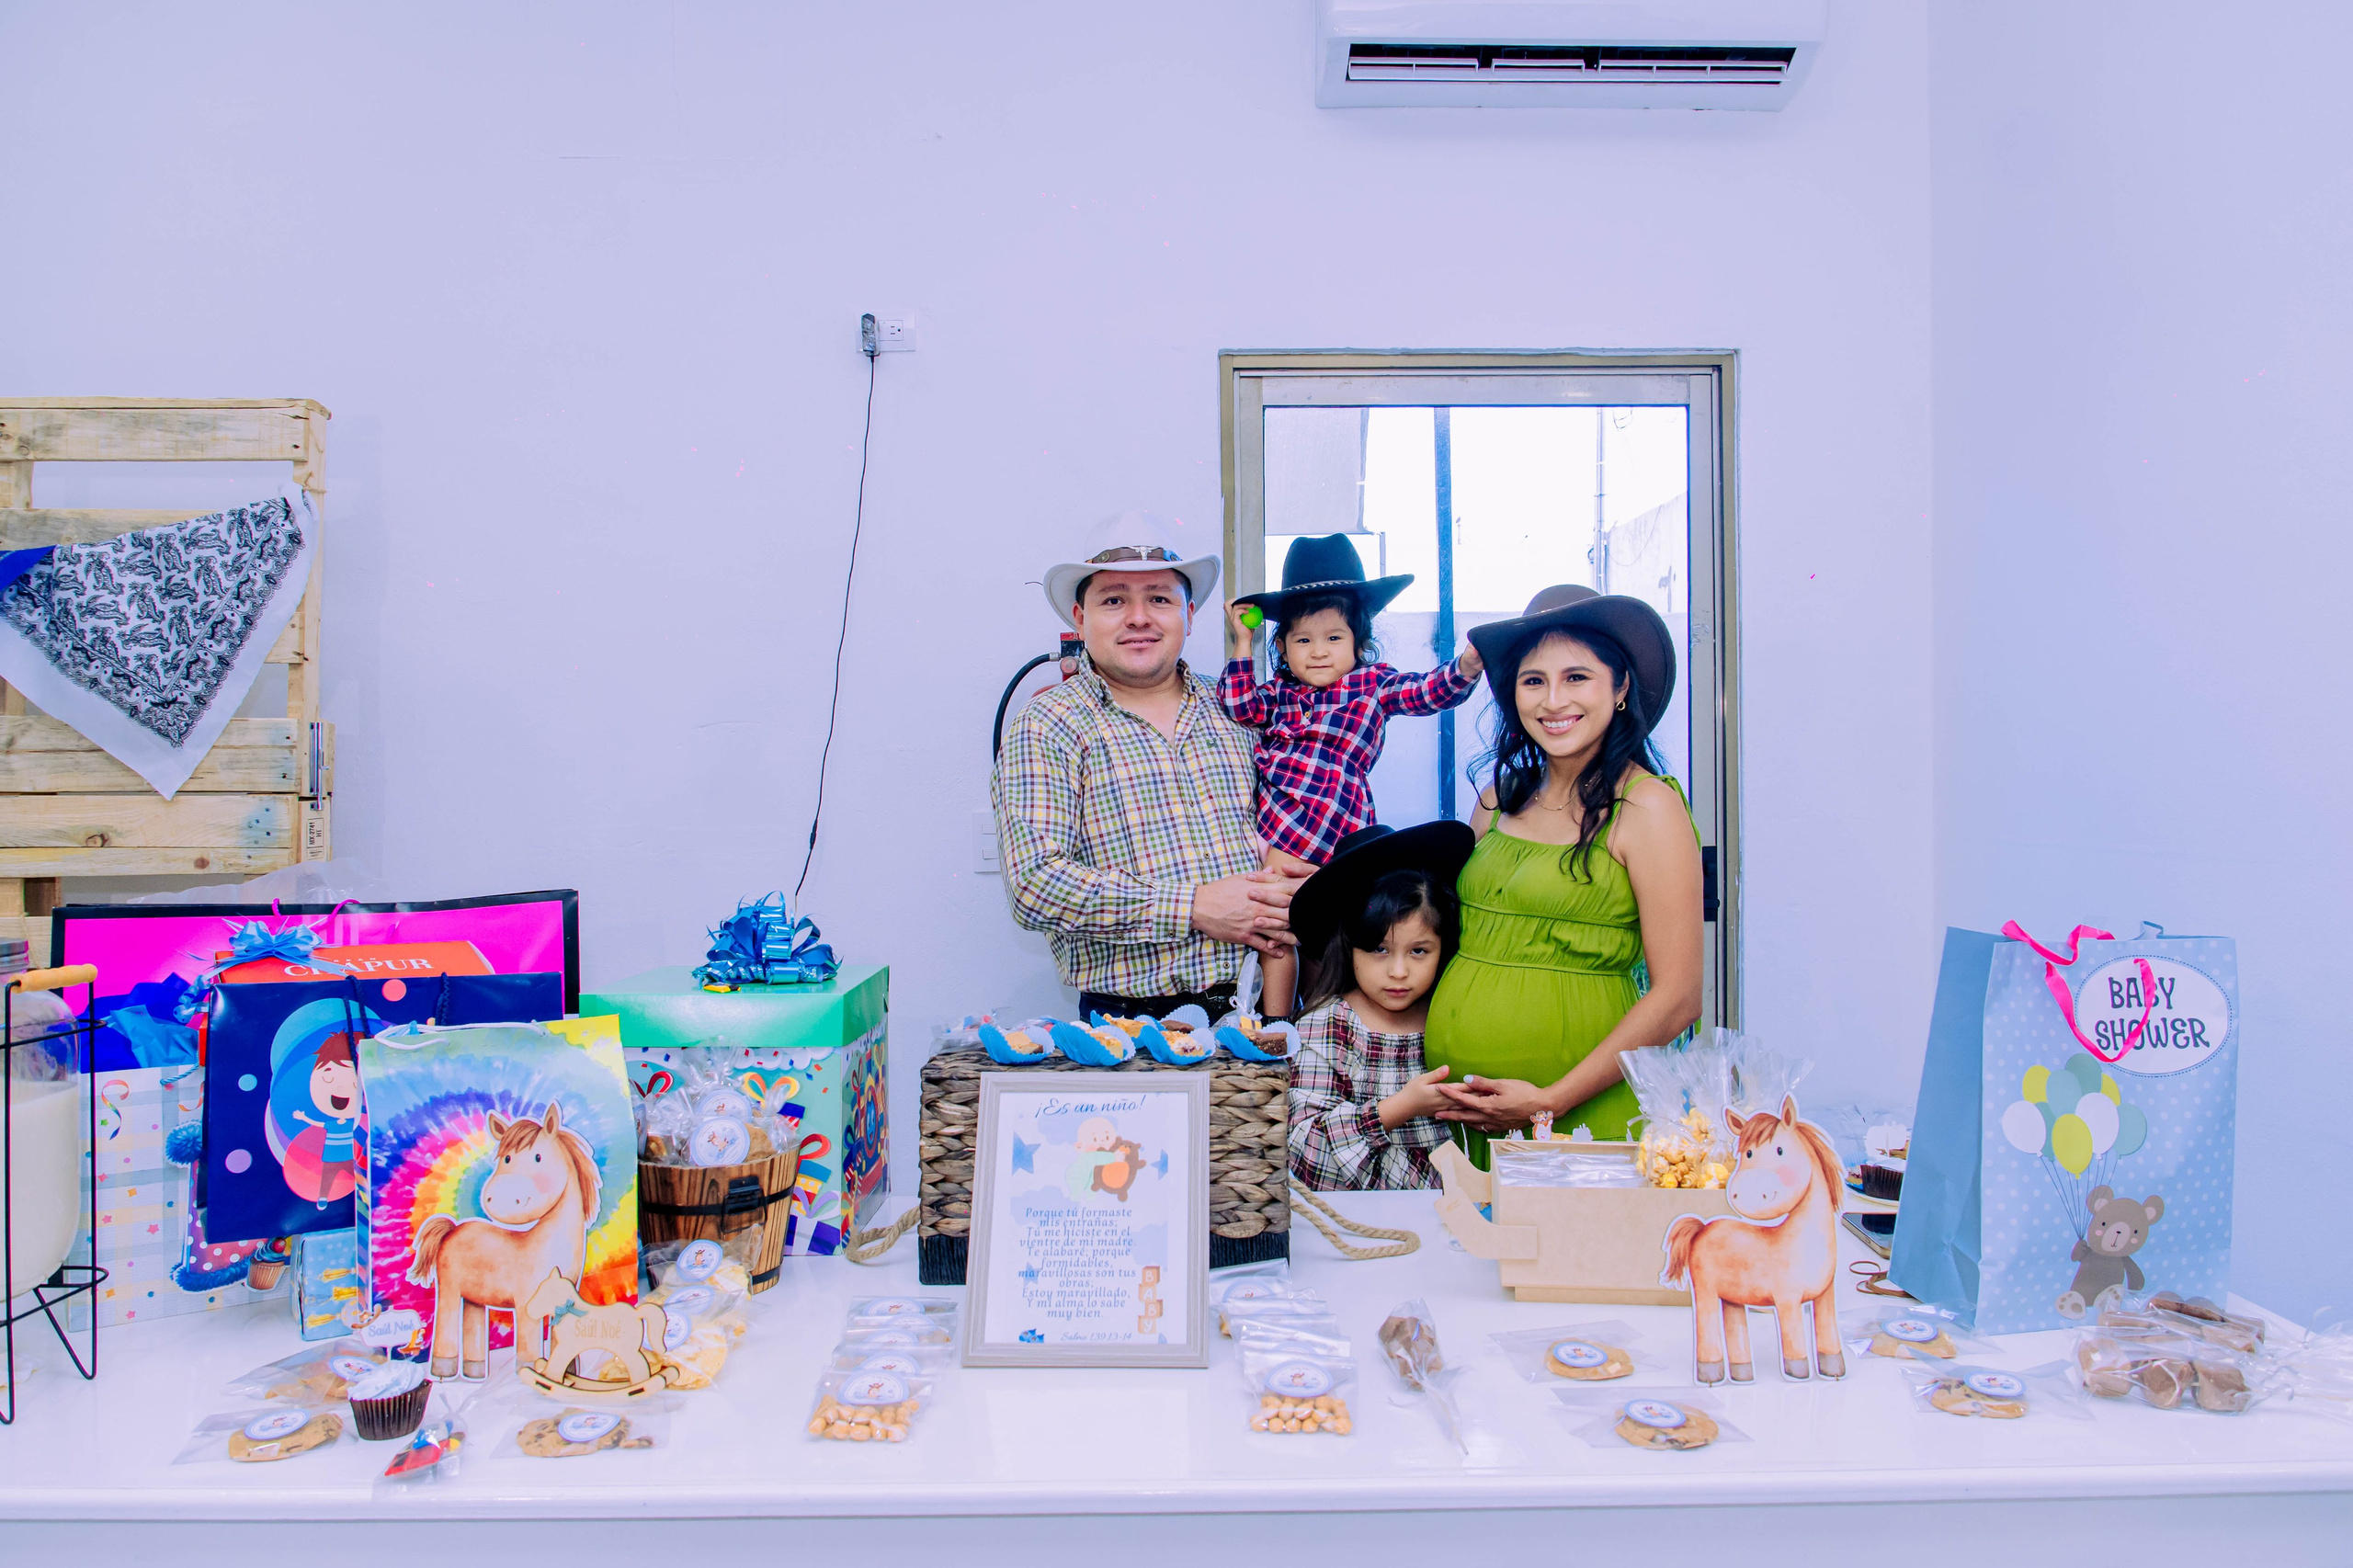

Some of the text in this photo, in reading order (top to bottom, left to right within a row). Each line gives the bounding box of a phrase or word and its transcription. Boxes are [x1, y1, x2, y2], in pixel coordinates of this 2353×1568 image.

[284, 959, 434, 977] CAPUR
[2095, 1017, 2211, 1051] SHOWER
[1074, 1102, 1097, 1113] un
[1100, 1094, 1146, 1114] niño!
[1026, 1207, 1132, 1220] Porque tú formaste
[1040, 1218, 1060, 1227] mis
[1027, 1225, 1131, 1237] Tú me hiciste en el
[1019, 1237, 1060, 1247] vientre
[1063, 1236, 1076, 1246] de
[1079, 1236, 1094, 1246] mi
[1027, 1246, 1040, 1256] Te
[1092, 1247, 1131, 1259] porque
[1040, 1257, 1113, 1269] formidables,
[1017, 1267, 1136, 1278] maravillosas son tus
[1022, 1287, 1052, 1300] Estoy
[1027, 1296, 1126, 1308] Y mi alma lo sabe
[1047, 1310, 1073, 1321] muy
[574, 1319, 597, 1338] Saúl
